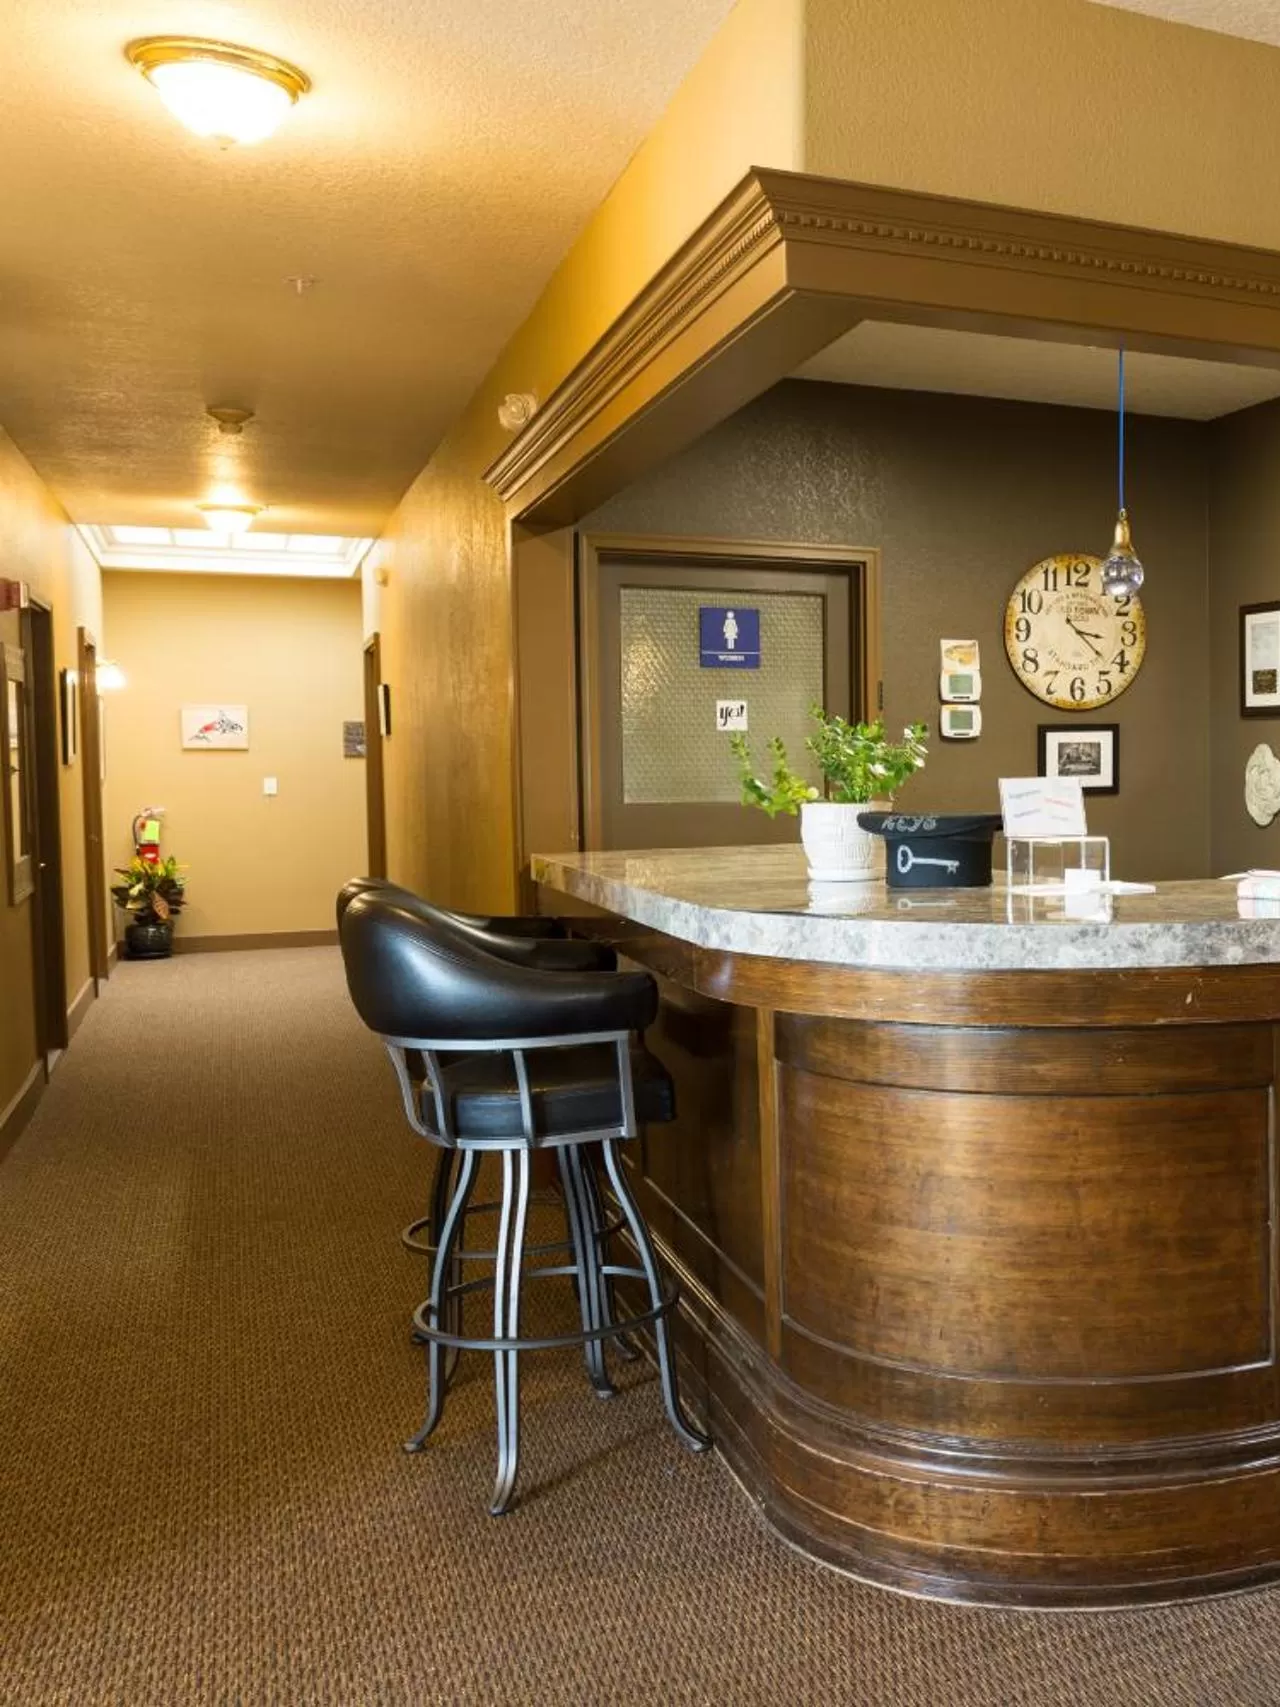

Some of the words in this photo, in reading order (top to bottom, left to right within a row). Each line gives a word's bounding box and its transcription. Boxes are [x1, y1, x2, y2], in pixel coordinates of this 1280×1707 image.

[1043, 567, 1058, 592] 11
[1065, 561, 1091, 588] 12
[1020, 588, 1043, 615] 10
[1114, 595, 1131, 617] 2
[1015, 617, 1031, 642] 9
[1121, 620, 1137, 647] 3
[1022, 648, 1039, 673] 8
[1111, 649, 1130, 673] 4
[1043, 670, 1060, 695] 7
[1069, 677, 1085, 702] 6
[1096, 670, 1112, 696] 5
[719, 704, 745, 727] yes!
